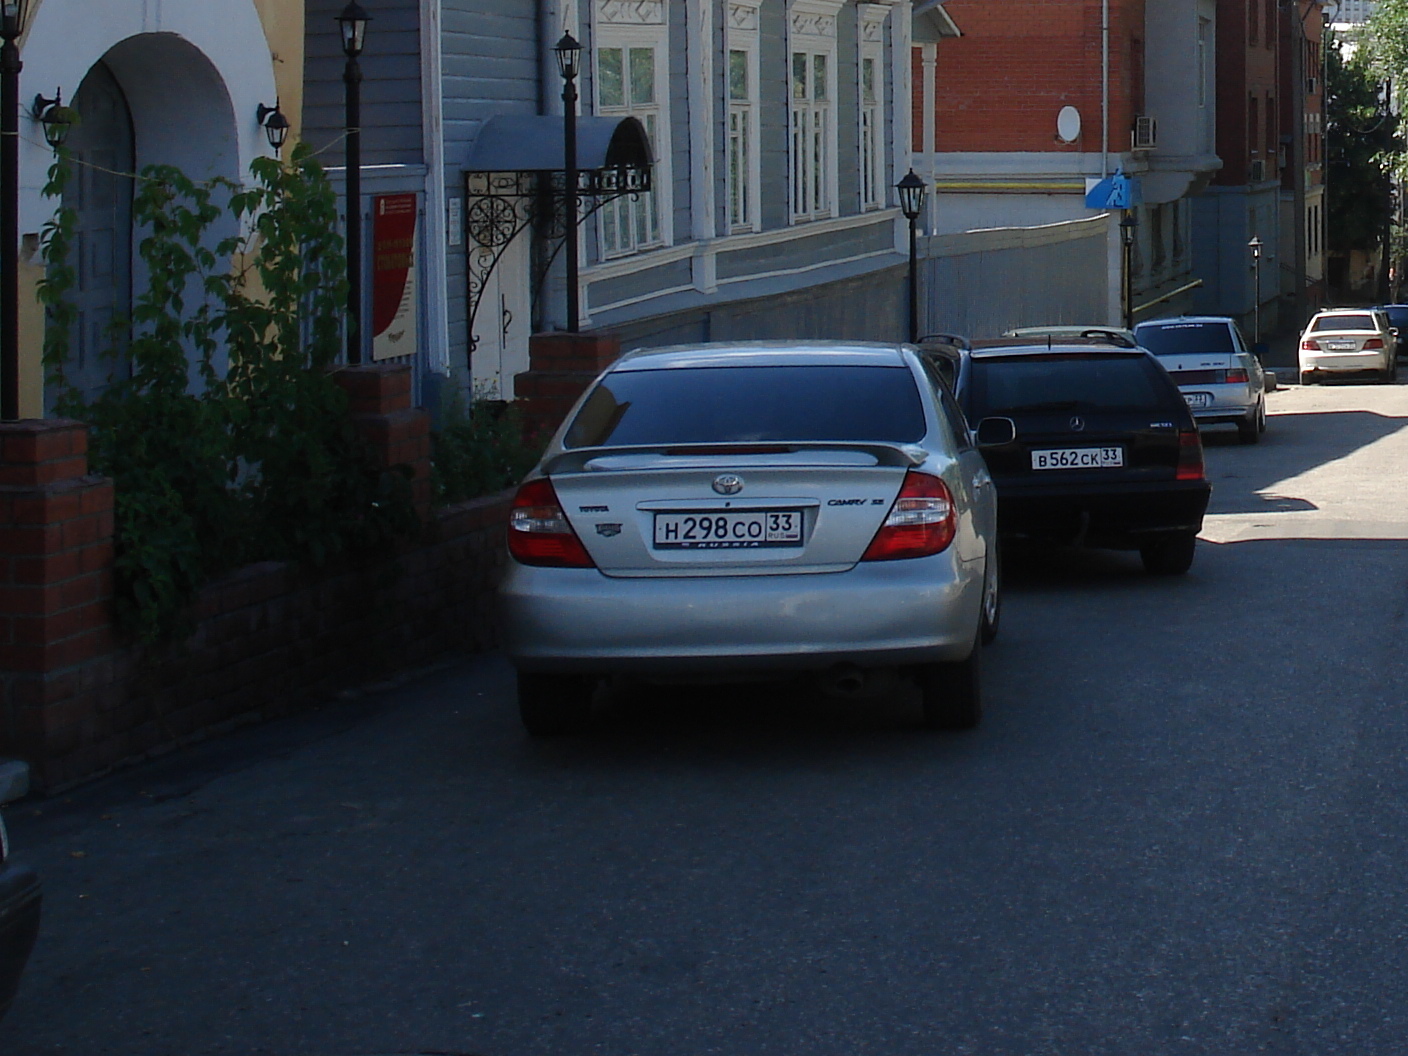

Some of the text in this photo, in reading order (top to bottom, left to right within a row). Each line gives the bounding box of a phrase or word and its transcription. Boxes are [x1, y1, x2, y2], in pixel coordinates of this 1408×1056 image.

[1102, 448, 1118, 461] 33
[665, 514, 793, 540] Н298СО 33
